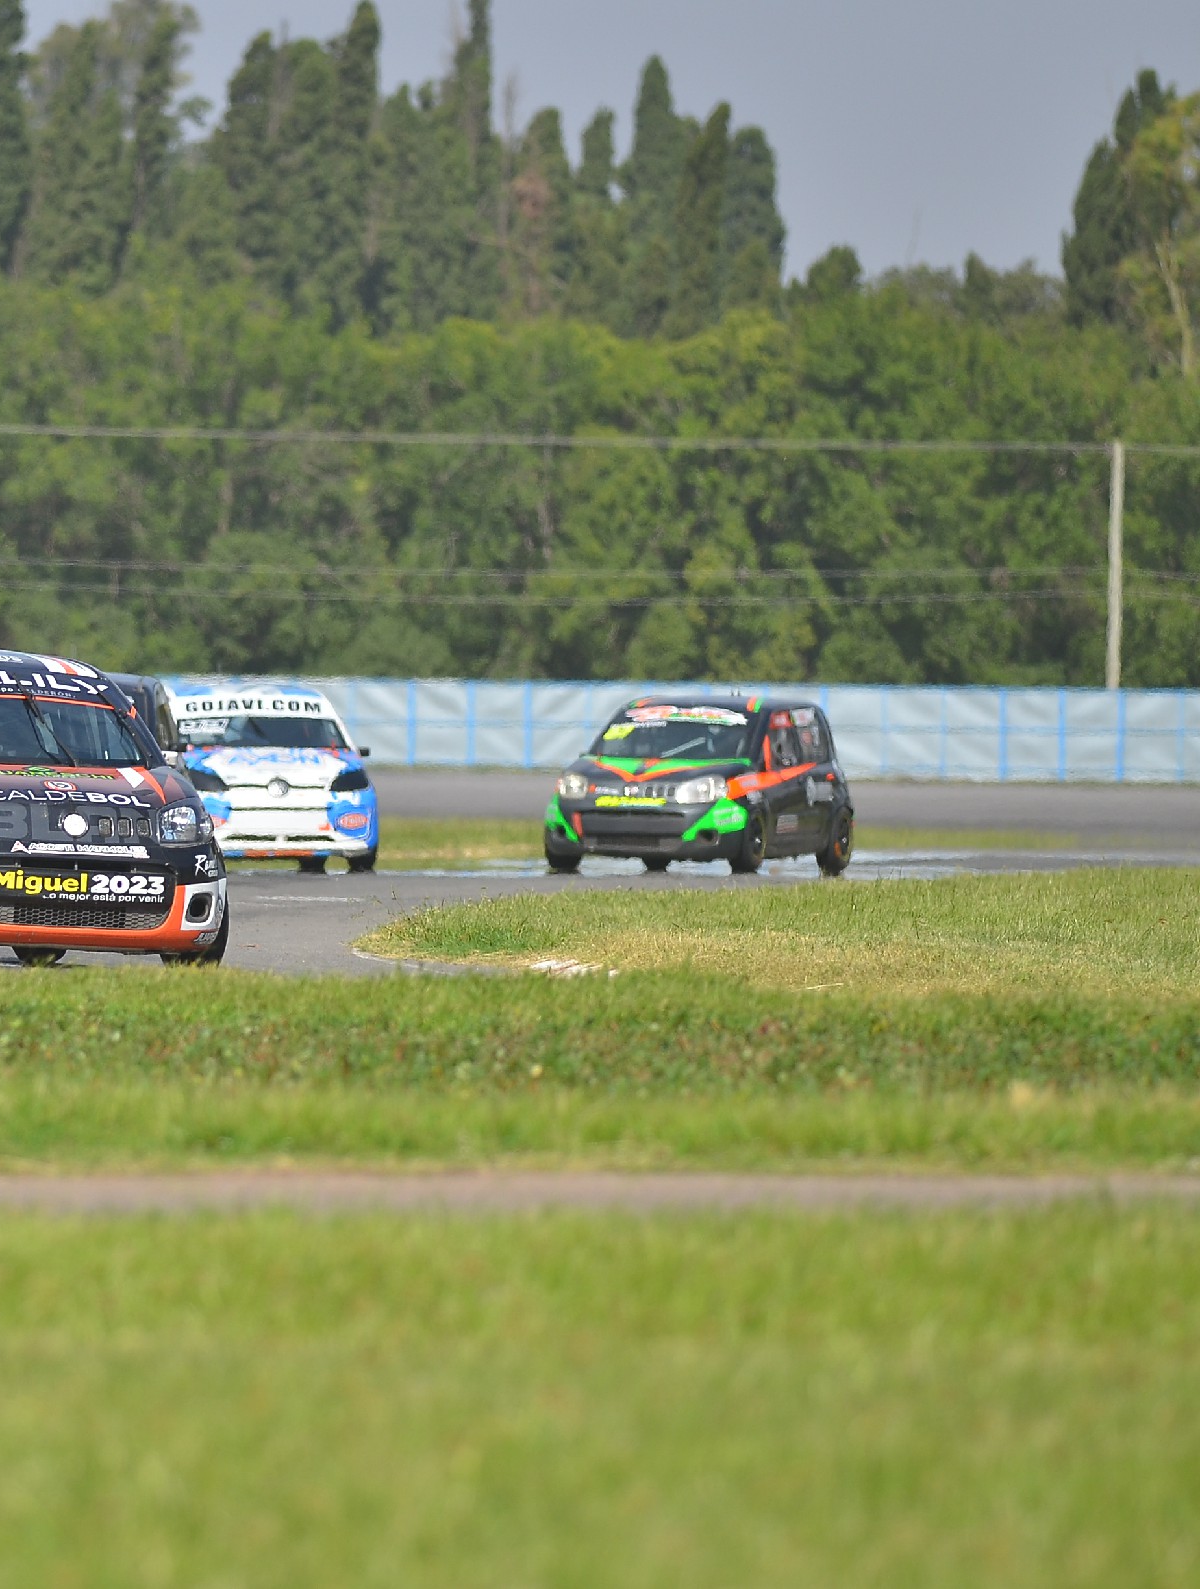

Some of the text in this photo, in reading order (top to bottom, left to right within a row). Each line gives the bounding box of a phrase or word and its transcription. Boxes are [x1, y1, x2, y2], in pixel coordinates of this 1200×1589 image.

[91, 874, 165, 895] 2023
[59, 893, 90, 903] mejor
[93, 893, 116, 902] está
[118, 895, 137, 903] por
[138, 895, 165, 903] venir
